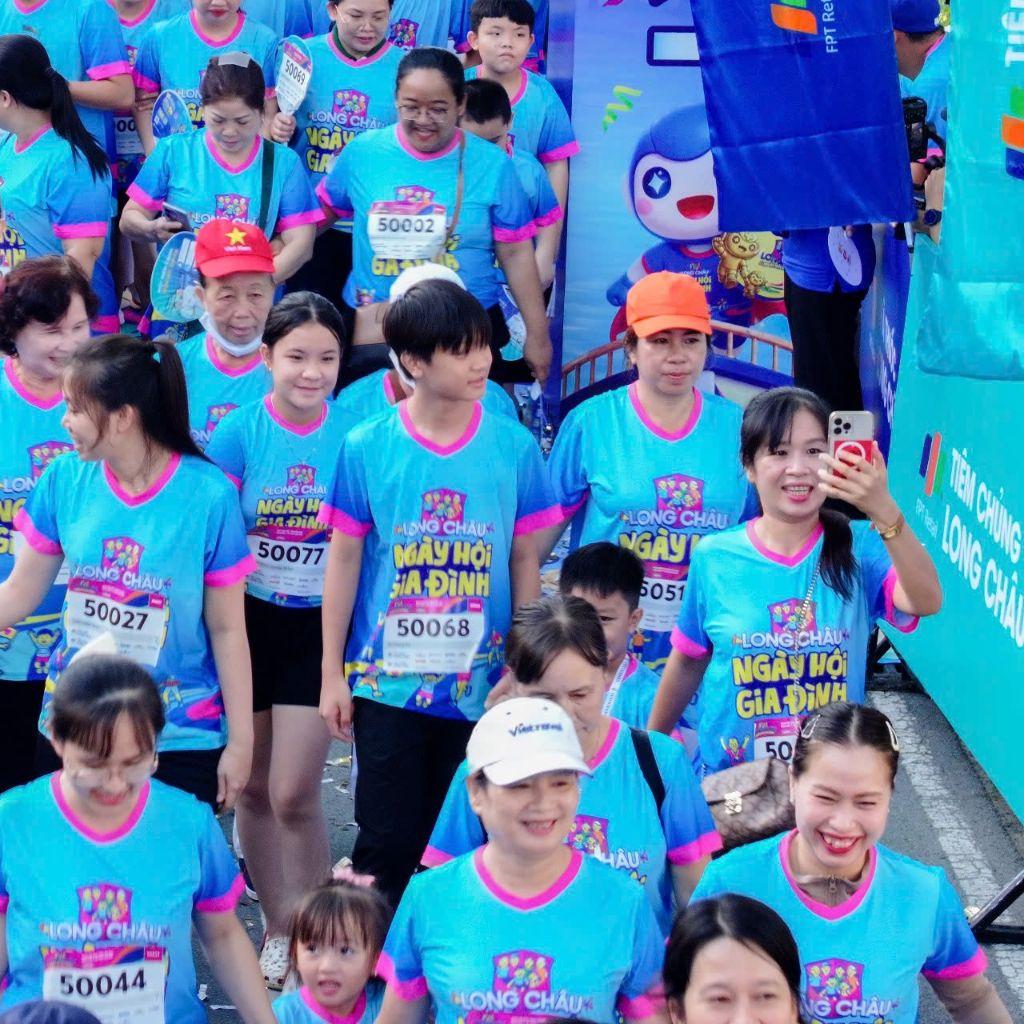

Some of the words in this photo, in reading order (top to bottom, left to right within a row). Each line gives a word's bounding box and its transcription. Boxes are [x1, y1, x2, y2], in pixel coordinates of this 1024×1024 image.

[825, 25, 839, 54] FPT
[285, 58, 306, 86] 50069
[377, 217, 435, 234] 50002
[3, 477, 36, 493] LON
[629, 509, 677, 527] LONG
[679, 505, 729, 529] CHÂU
[949, 446, 977, 513] TIÊM
[976, 481, 1023, 566] CHỦNG
[442, 519, 487, 538] CHÂU
[257, 541, 325, 567] 50077
[941, 503, 984, 591] LONG
[73, 564, 121, 582] LONG
[121, 570, 165, 591] CHÂU
[639, 580, 686, 603] 5051
[83, 598, 149, 631] 50027
[396, 618, 471, 639] 50068
[742, 629, 796, 649] LONG
[796, 626, 843, 647] CHÂU
[49, 922, 104, 943] LONG
[105, 921, 164, 943] CHÂU
[59, 968, 147, 997] 50044
[460, 990, 520, 1012] LONG
[523, 988, 584, 1013] CHÂU
[835, 994, 893, 1018] CHÂU
